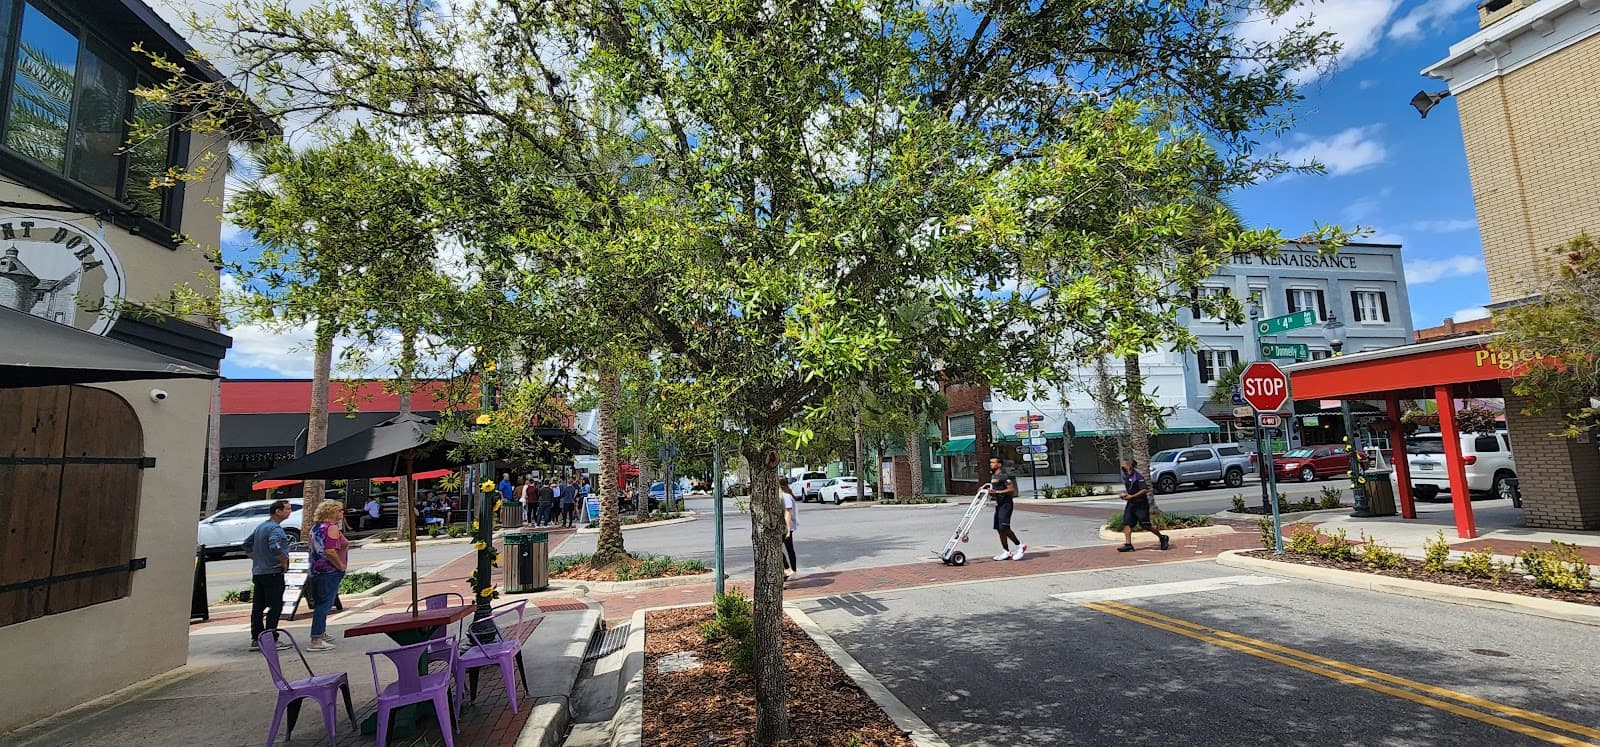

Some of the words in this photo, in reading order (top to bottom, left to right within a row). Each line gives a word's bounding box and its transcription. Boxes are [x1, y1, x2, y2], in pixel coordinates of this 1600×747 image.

[50, 226, 104, 272] DORA
[1232, 252, 1253, 265] HE
[1261, 252, 1357, 269] RENAISSANCE
[1275, 345, 1298, 359] Donnelly
[1245, 377, 1284, 396] STOP
